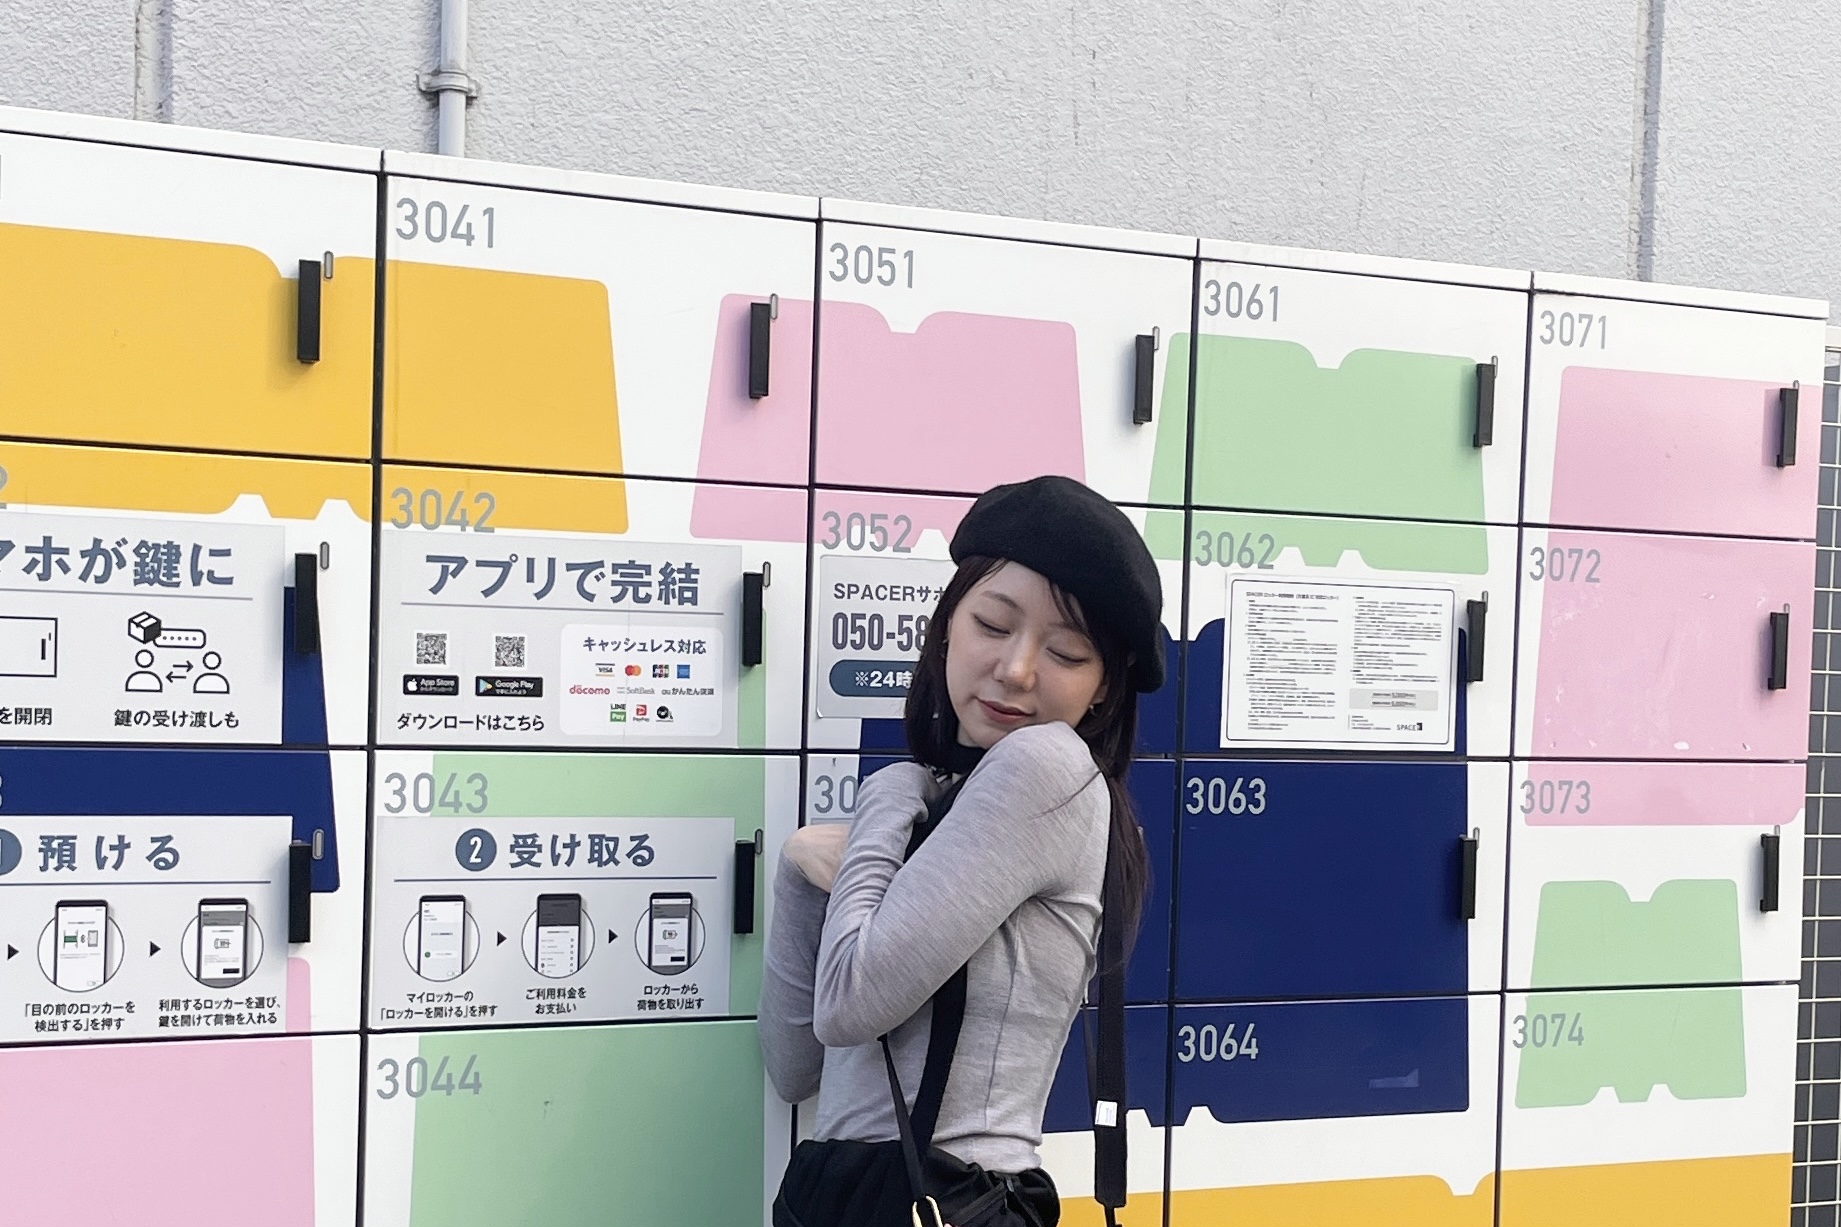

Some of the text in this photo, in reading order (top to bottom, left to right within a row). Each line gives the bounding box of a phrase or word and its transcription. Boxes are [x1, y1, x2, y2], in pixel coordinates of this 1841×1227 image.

[395, 198, 497, 249] 3041
[828, 242, 916, 289] 3051
[1203, 280, 1281, 323] 3061
[1539, 311, 1607, 350] 3071
[391, 487, 496, 533] 3042
[821, 511, 912, 553] 3052
[1195, 531, 1275, 572] 3062
[1529, 547, 1602, 585] 3072
[426, 553, 700, 606] アプリで完結
[583, 636, 707, 655] キャッシュレス対応
[420, 679, 455, 687] App Store
[495, 680, 534, 689] Google Play
[570, 685, 610, 695] docomo
[626, 687, 655, 695] SoftBank
[114, 709, 240, 729] 鍵の受け渡しも
[397, 713, 545, 731] ダウンロードはこちら
[384, 772, 488, 814] 3043
[814, 775, 866, 813] 30
[1185, 777, 1267, 816] 3063
[1519, 780, 1592, 816] 3073
[38, 835, 180, 872] 預ける
[509, 833, 655, 868] 受け取る
[406, 990, 474, 1003] マイロッカーの
[525, 987, 587, 1000] ご利用料金を
[637, 998, 704, 1011] 荷物を取り出す
[643, 983, 698, 996] ロッカーから
[24, 1001, 135, 1017] 「目の前のロッカーを
[35, 1018, 125, 1033] 検出する」を押す
[159, 1012, 277, 1027] 鍵を開けて荷物を入れる
[380, 1005, 498, 1021] 「ロッカーを開ける」を押す
[535, 1002, 577, 1015] お支払い
[1177, 1023, 1259, 1064] 3064
[1512, 1013, 1586, 1049] 3074
[376, 1054, 482, 1100] 3044
